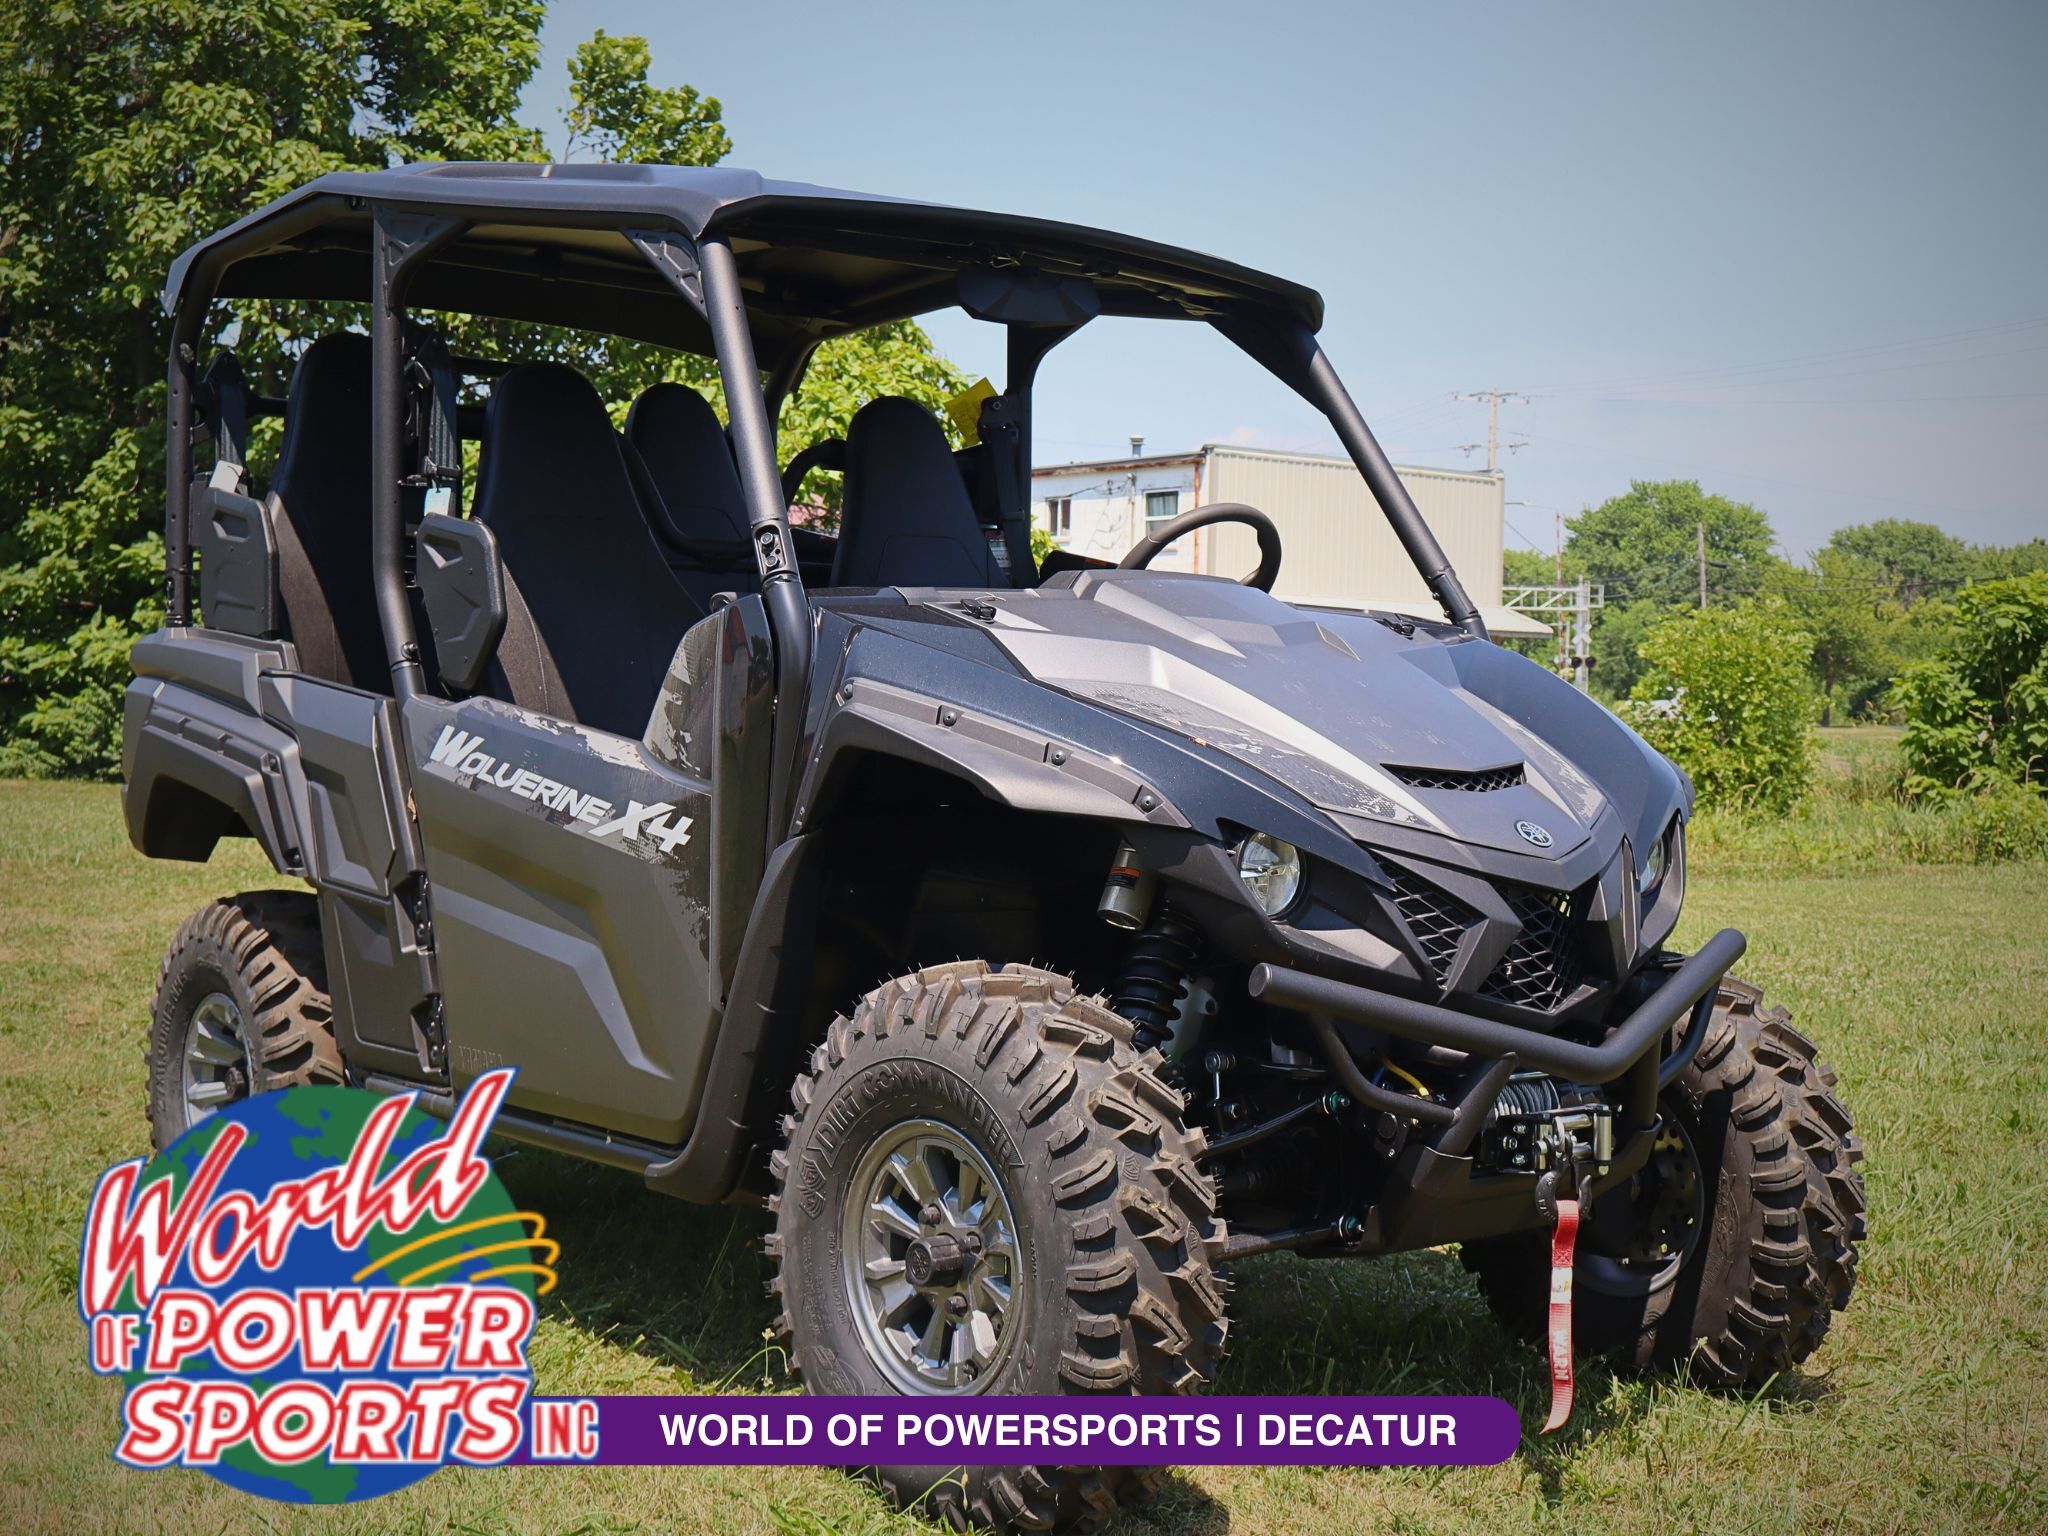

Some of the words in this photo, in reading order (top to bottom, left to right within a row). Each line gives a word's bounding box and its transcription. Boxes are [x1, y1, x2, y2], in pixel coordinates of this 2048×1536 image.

[430, 725, 613, 825] WOLVERINE
[588, 800, 694, 853] X4
[815, 1086, 861, 1149] DIRT
[861, 1061, 1012, 1170] COMMANDER
[1552, 1328, 1570, 1381] WARN
